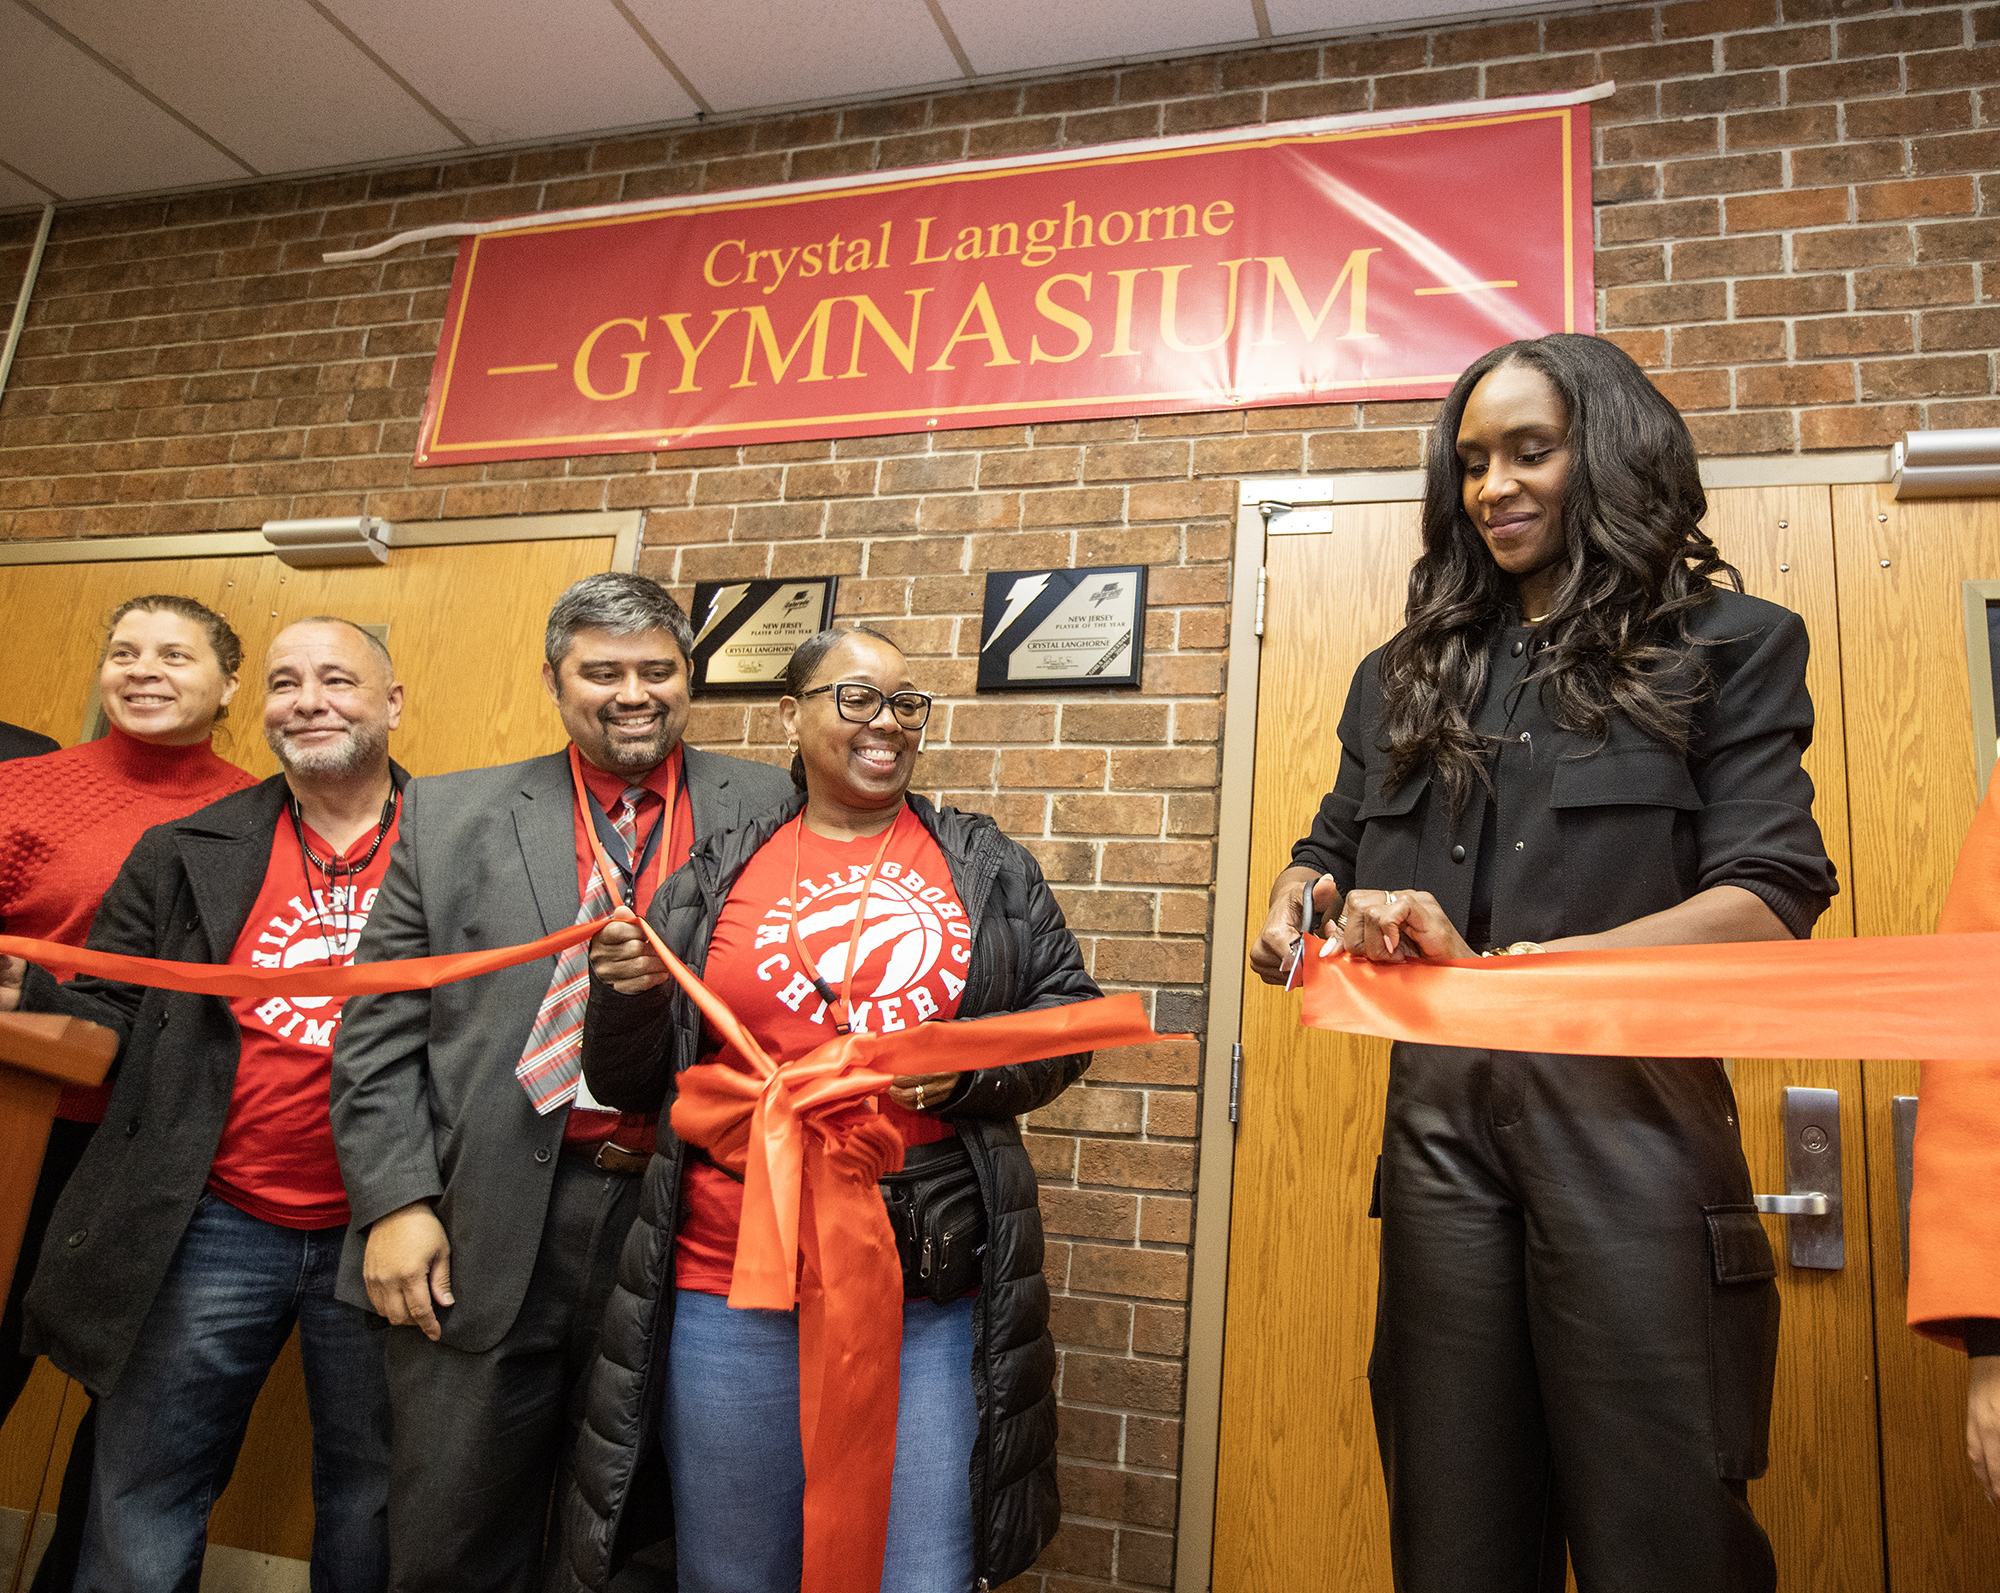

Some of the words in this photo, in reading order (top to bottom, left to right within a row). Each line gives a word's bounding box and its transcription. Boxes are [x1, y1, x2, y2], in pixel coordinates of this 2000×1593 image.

[703, 220, 893, 295] Crystal
[909, 199, 1235, 267] Langhorne
[573, 247, 1384, 401] GYMNASIUM
[1088, 614, 1114, 622] JERSEY
[780, 621, 803, 629] JERSEY
[1027, 641, 1059, 650] CRYSTAL
[1061, 640, 1111, 648] LANGHORNE
